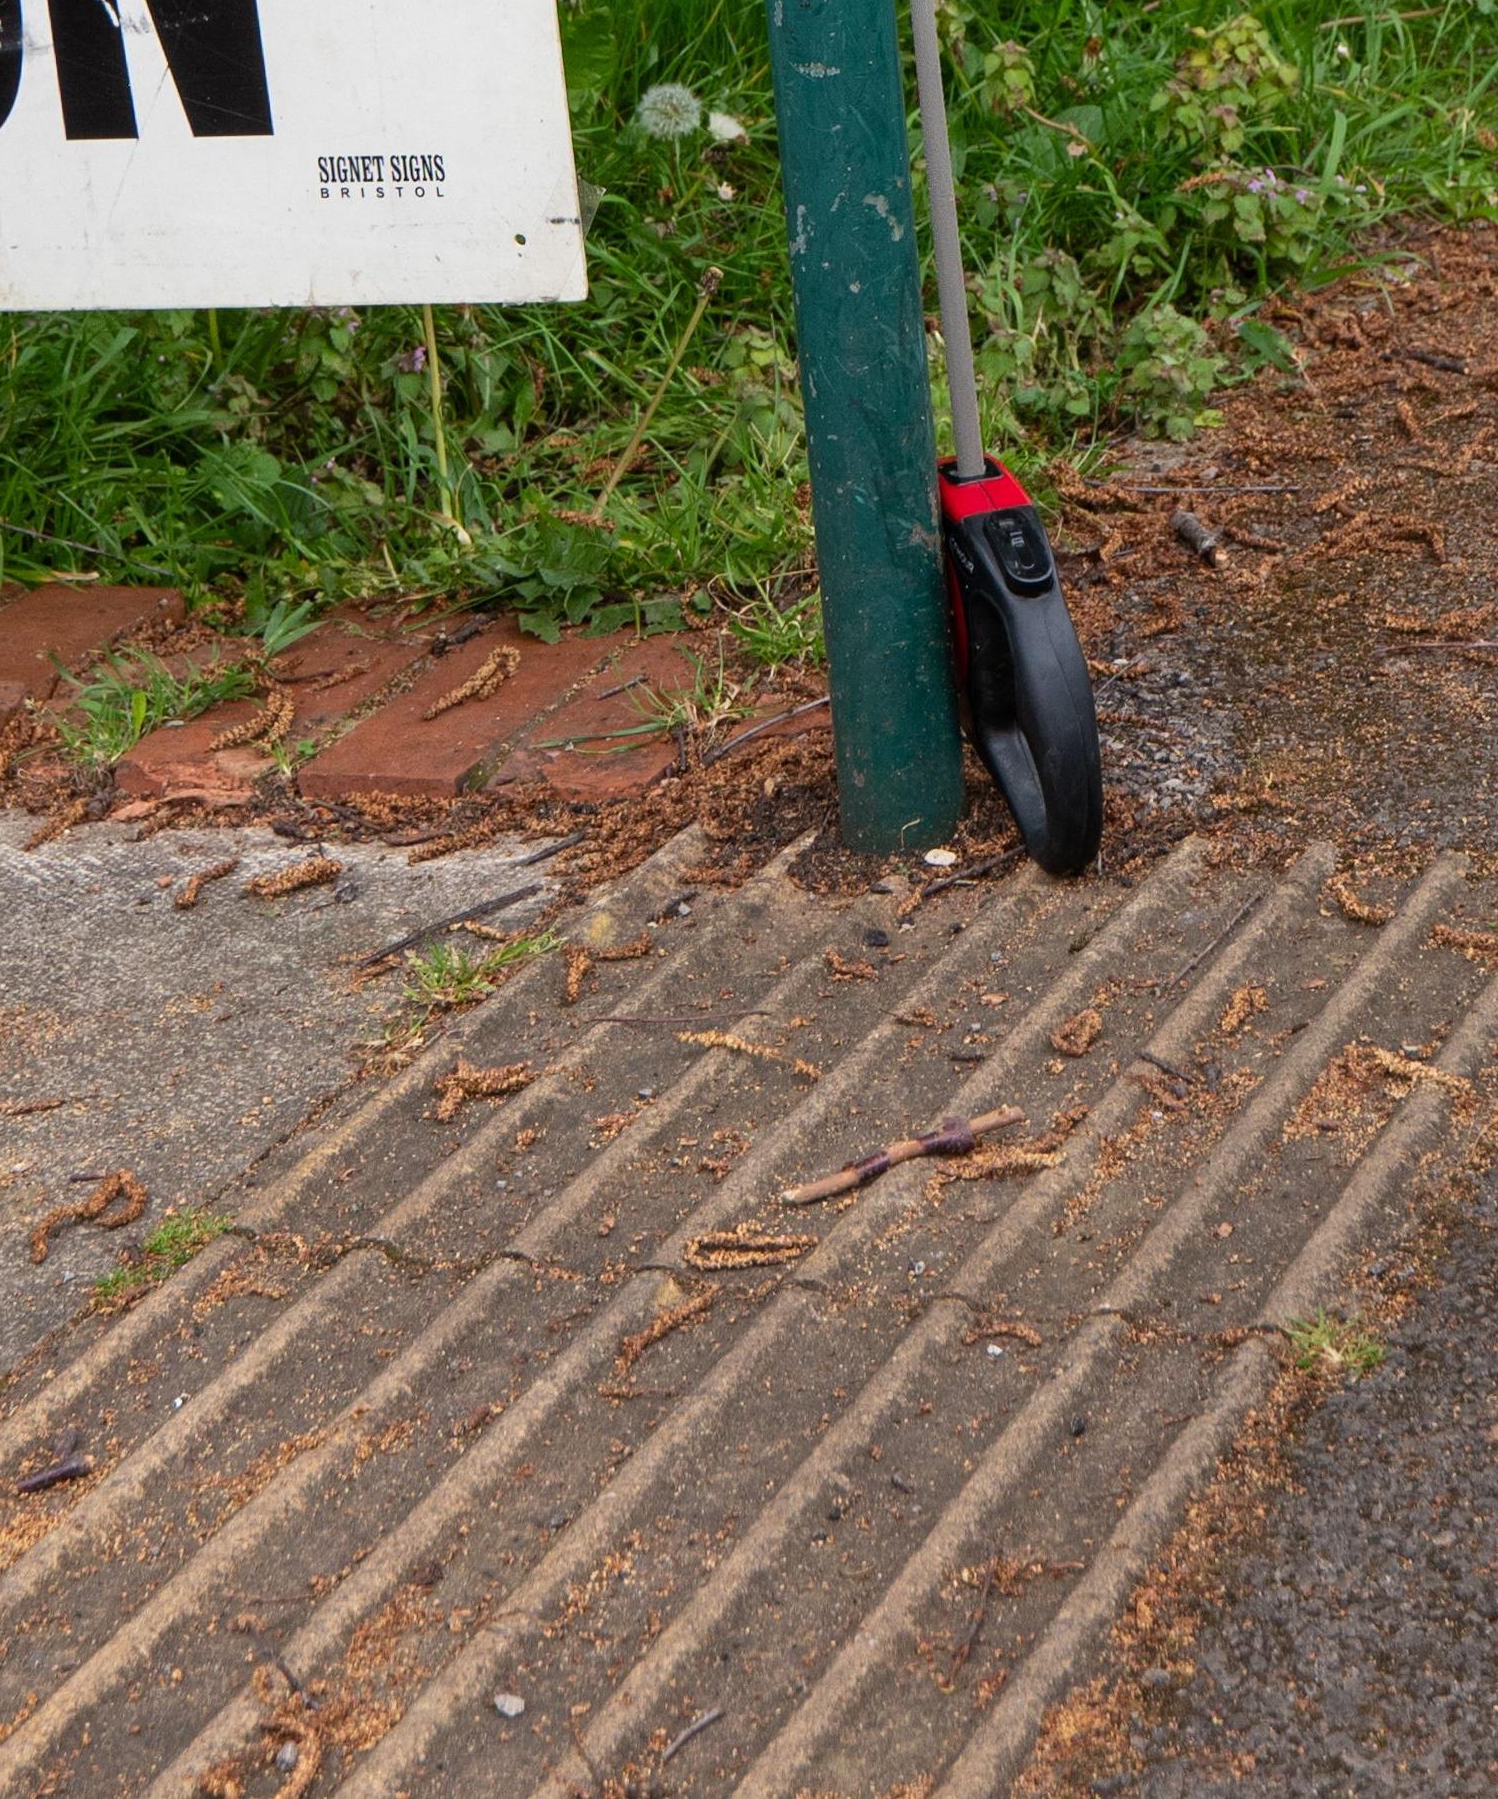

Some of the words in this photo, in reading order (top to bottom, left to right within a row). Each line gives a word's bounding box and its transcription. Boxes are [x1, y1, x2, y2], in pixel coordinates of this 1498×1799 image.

[318, 155, 385, 184] SIGNET
[390, 154, 446, 183] SIGNS
[319, 186, 445, 199] BRISTOL
